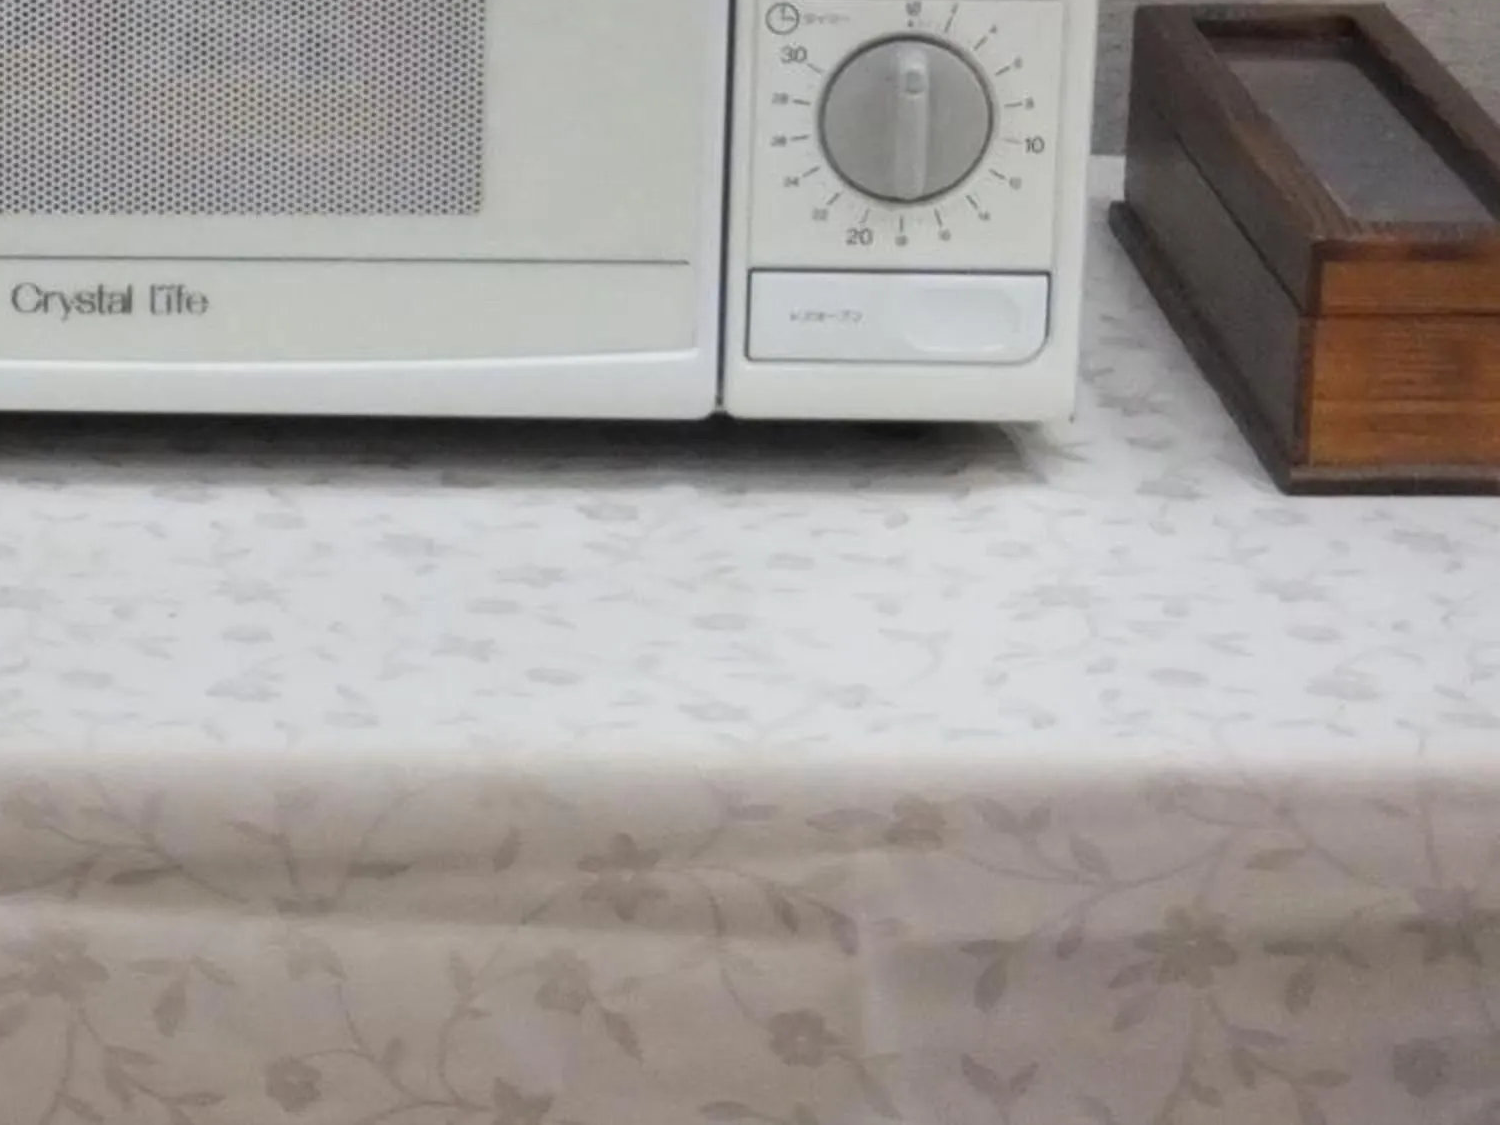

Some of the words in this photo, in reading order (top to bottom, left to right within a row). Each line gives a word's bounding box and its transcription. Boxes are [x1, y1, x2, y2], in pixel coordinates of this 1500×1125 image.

[780, 44, 808, 64] 30
[1025, 136, 1045, 154] 10
[846, 228, 873, 246] 20
[10, 282, 133, 323] Crystal
[149, 282, 210, 316] Life
